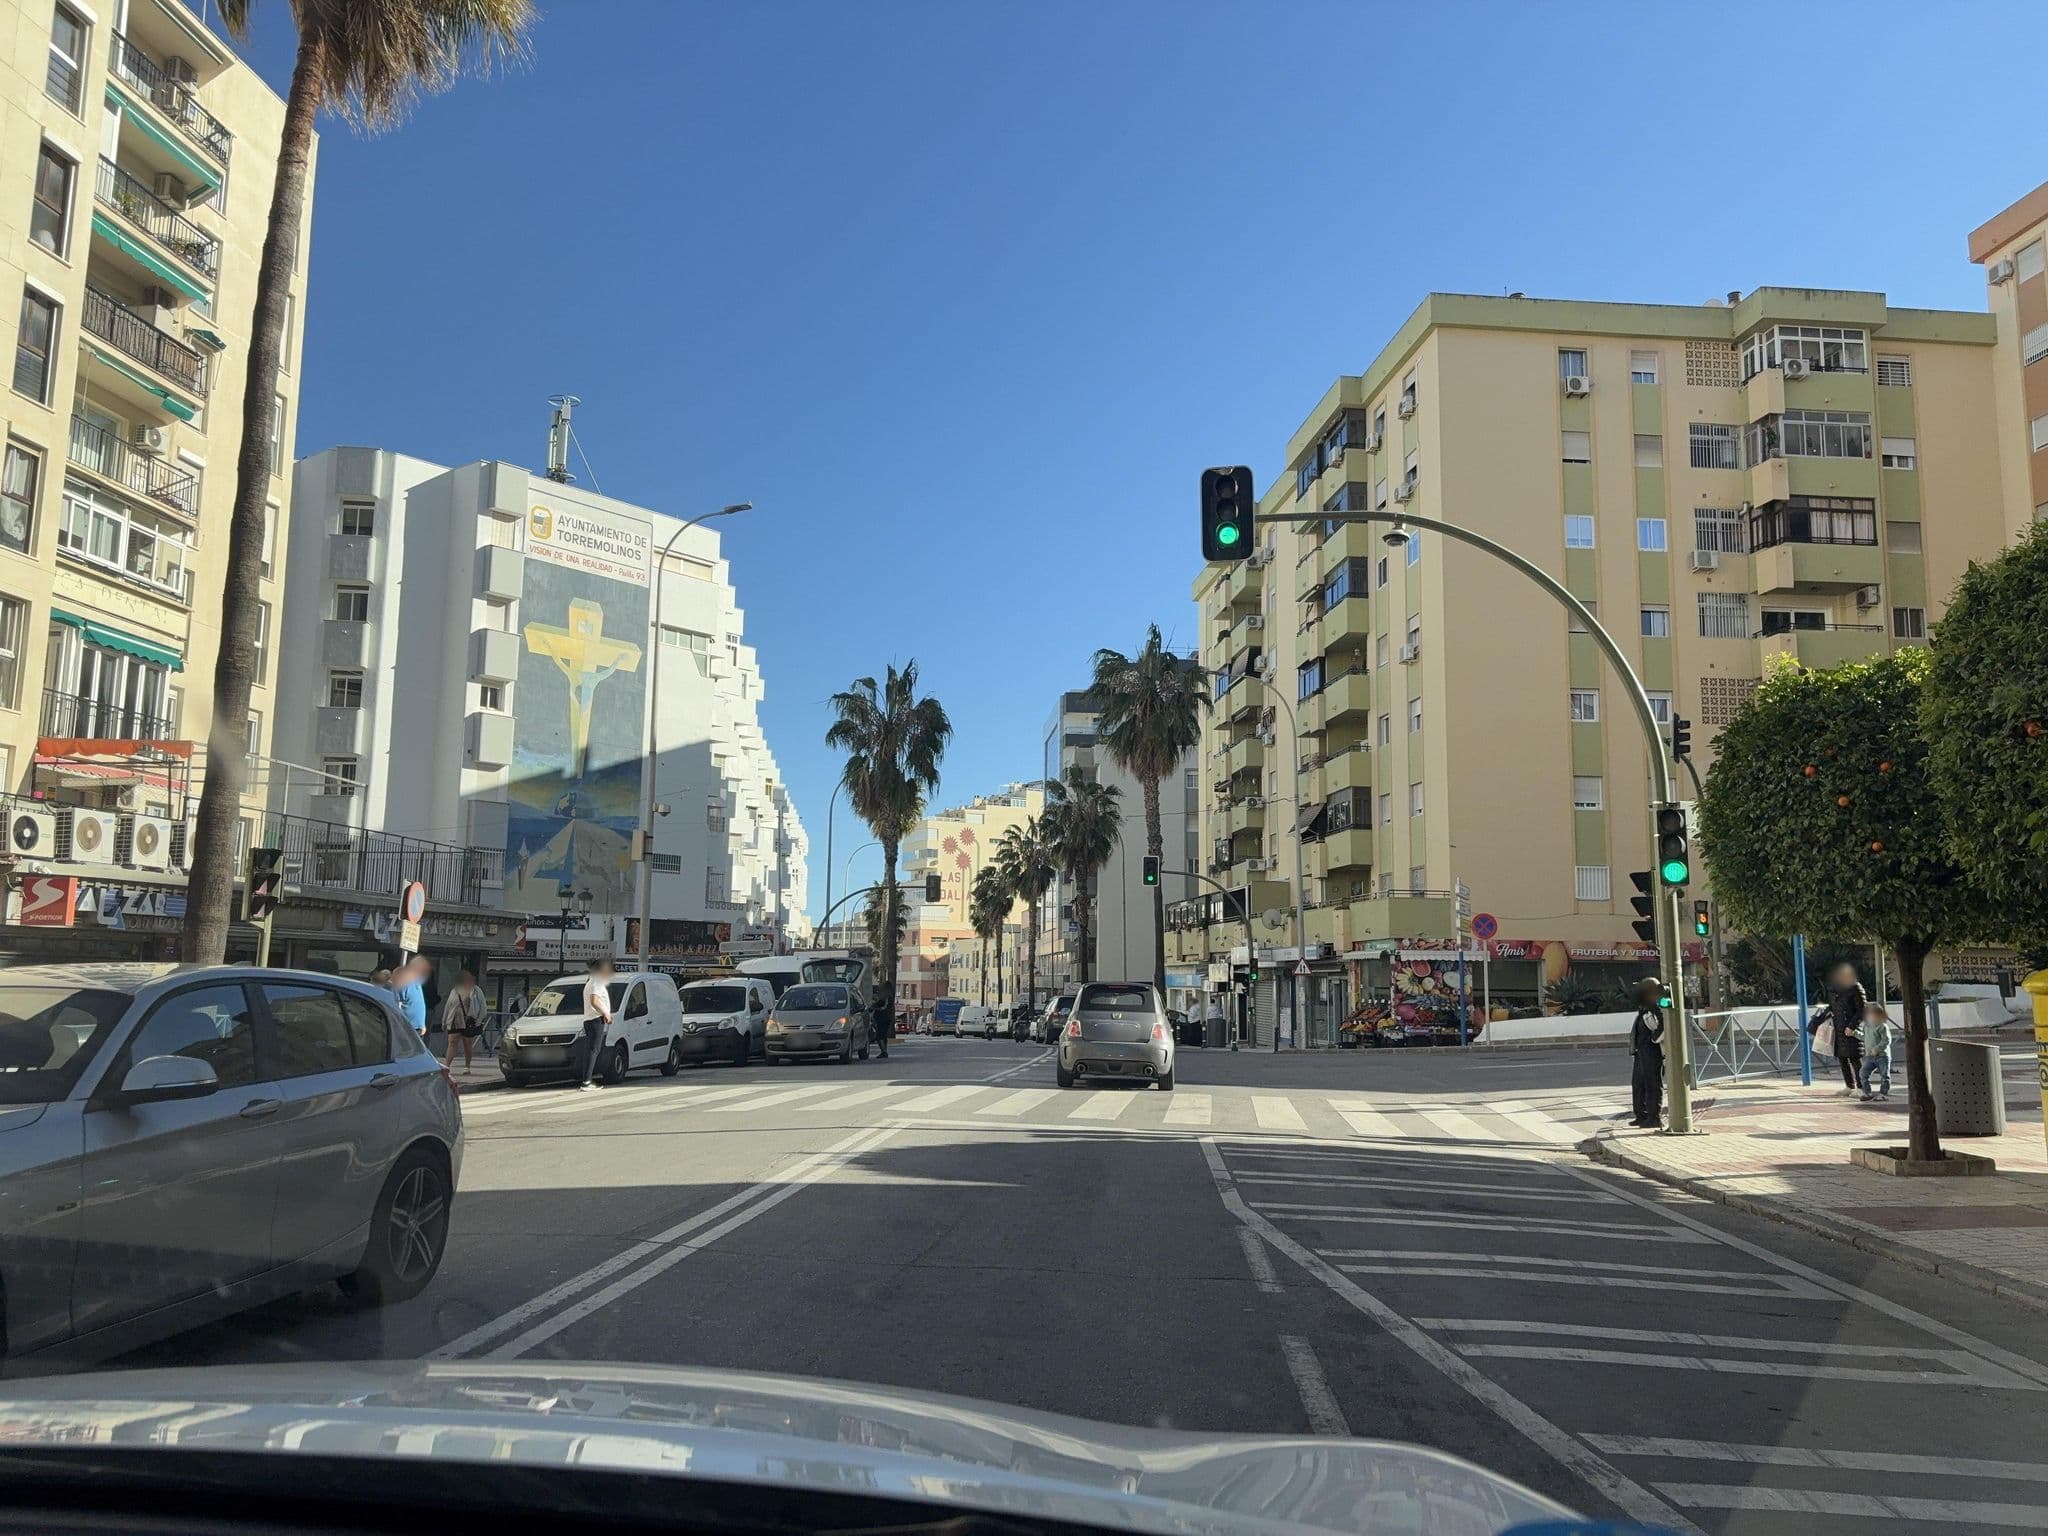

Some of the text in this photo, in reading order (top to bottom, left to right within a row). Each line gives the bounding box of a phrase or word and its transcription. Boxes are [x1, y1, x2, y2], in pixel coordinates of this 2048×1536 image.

[557, 529, 642, 560] TORREMOLINOS
[558, 515, 648, 548] AYUNTAMIENTO DE
[529, 545, 552, 558] VISION
[554, 552, 563, 560] DE
[566, 554, 580, 564] UNA
[582, 558, 613, 573] REALIDAD
[697, 944, 719, 954] PIZZ
